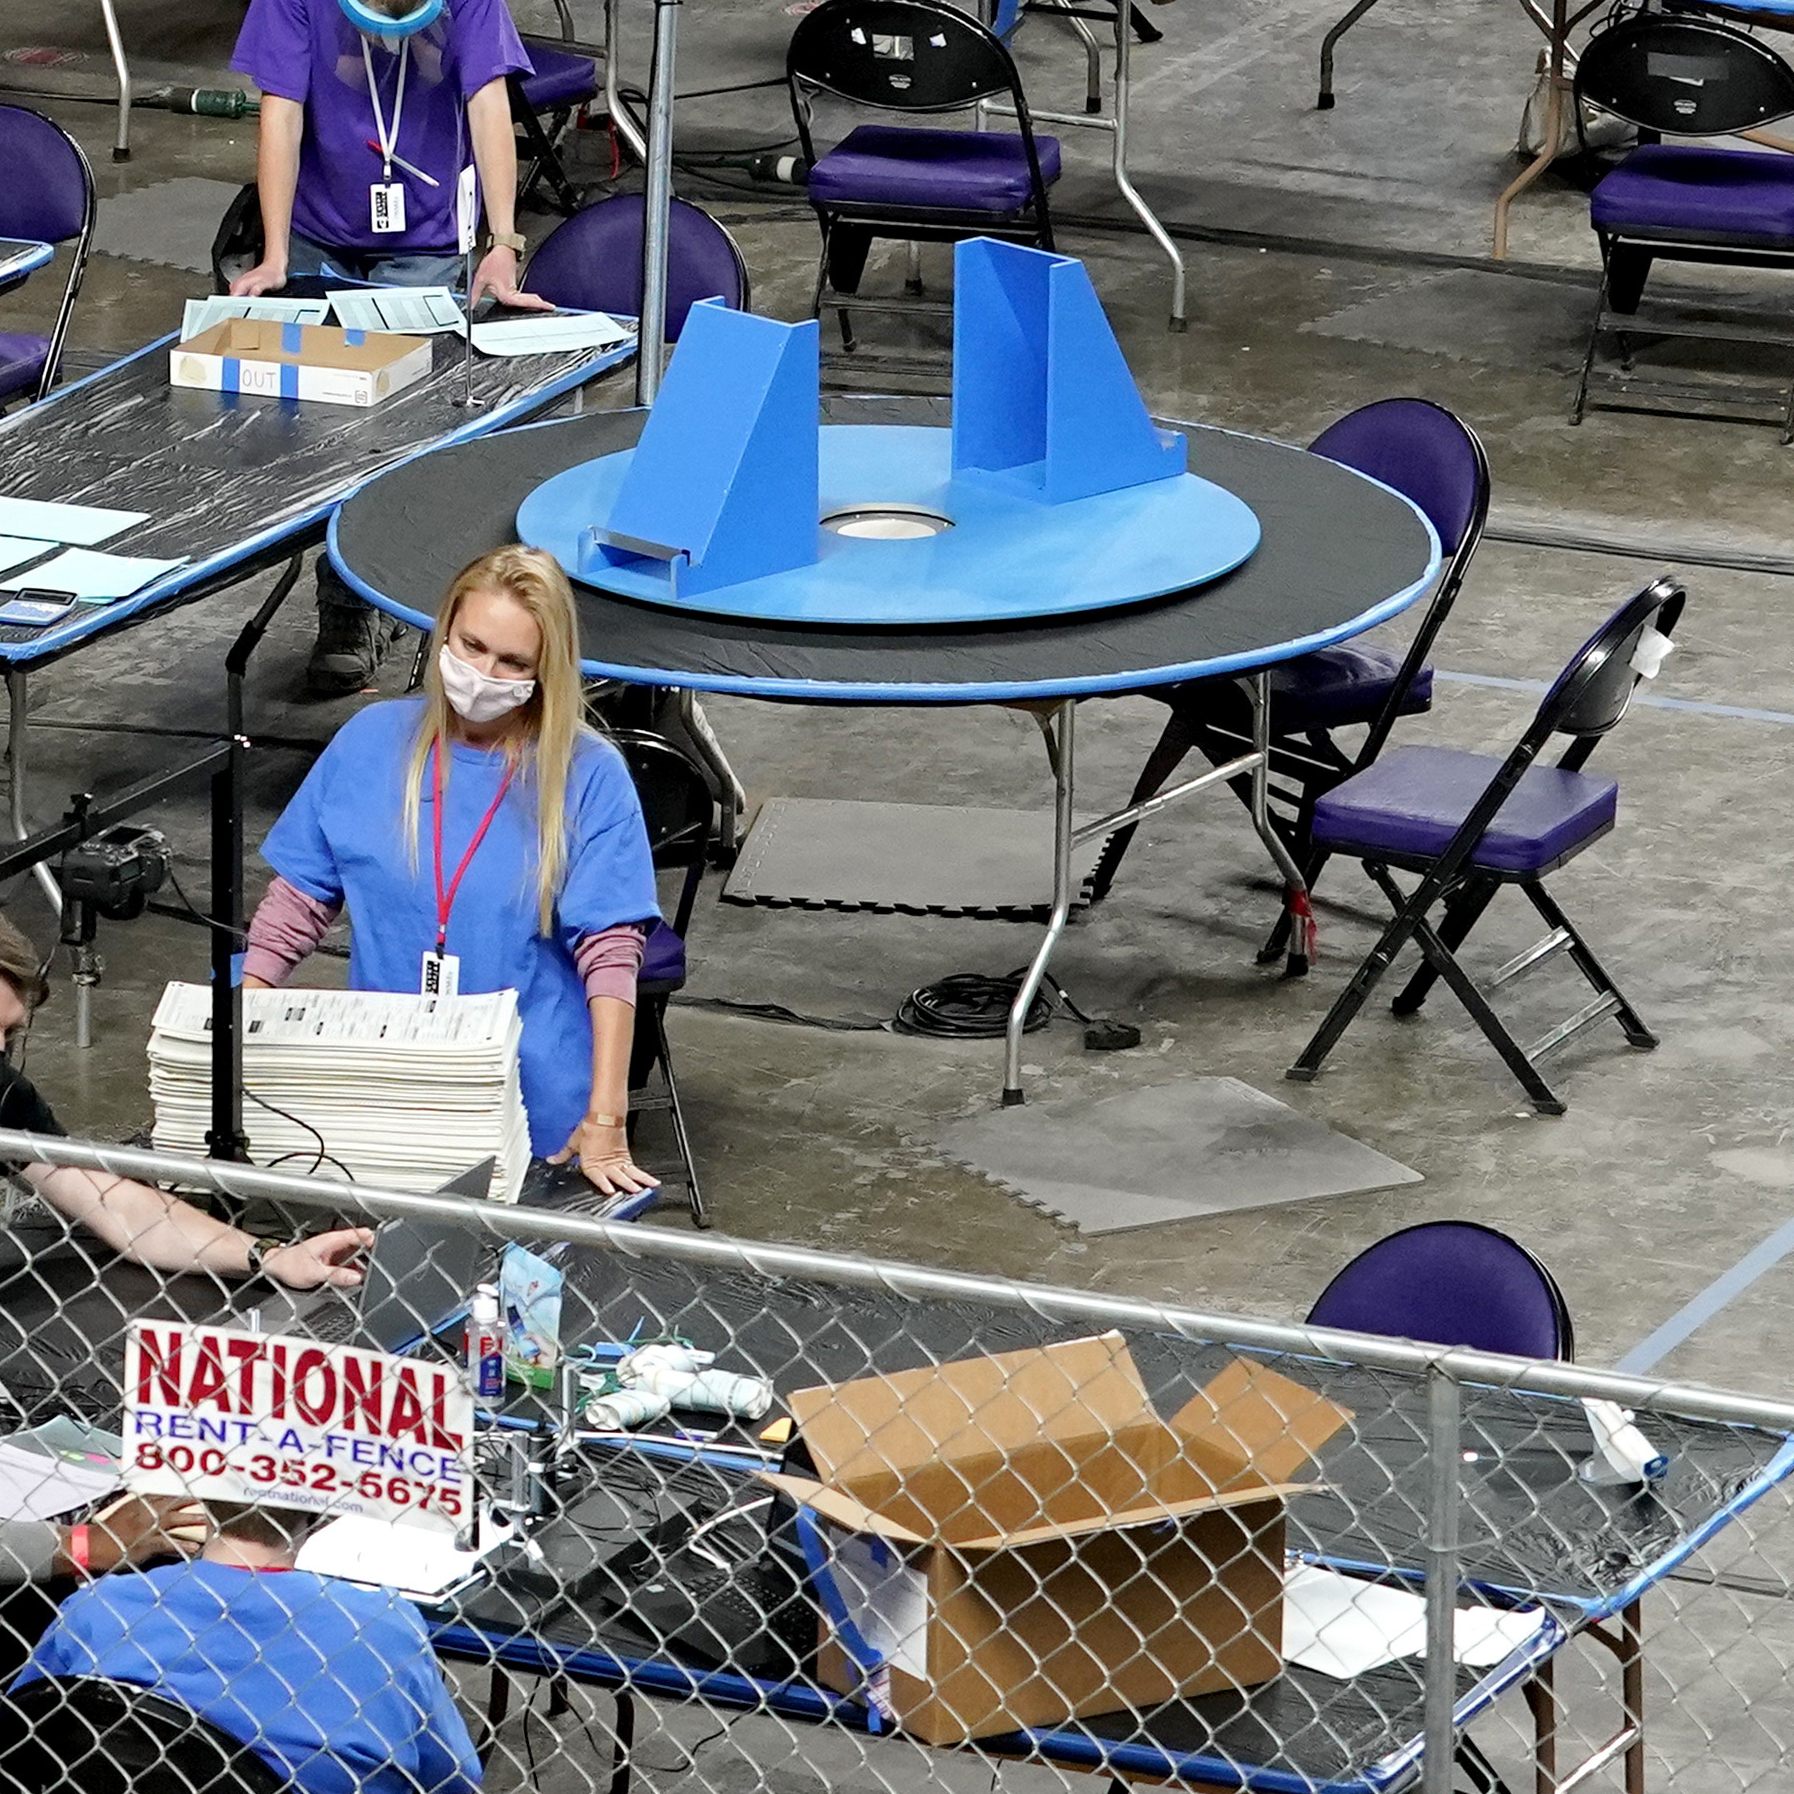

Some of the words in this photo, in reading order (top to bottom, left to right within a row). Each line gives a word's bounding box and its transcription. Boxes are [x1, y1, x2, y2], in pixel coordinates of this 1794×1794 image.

[242, 368, 277, 390] OUT
[137, 1328, 464, 1454] NATIONAL
[134, 1411, 463, 1484] RENT-A-FENCE
[135, 1442, 463, 1517] 800-352-5675
